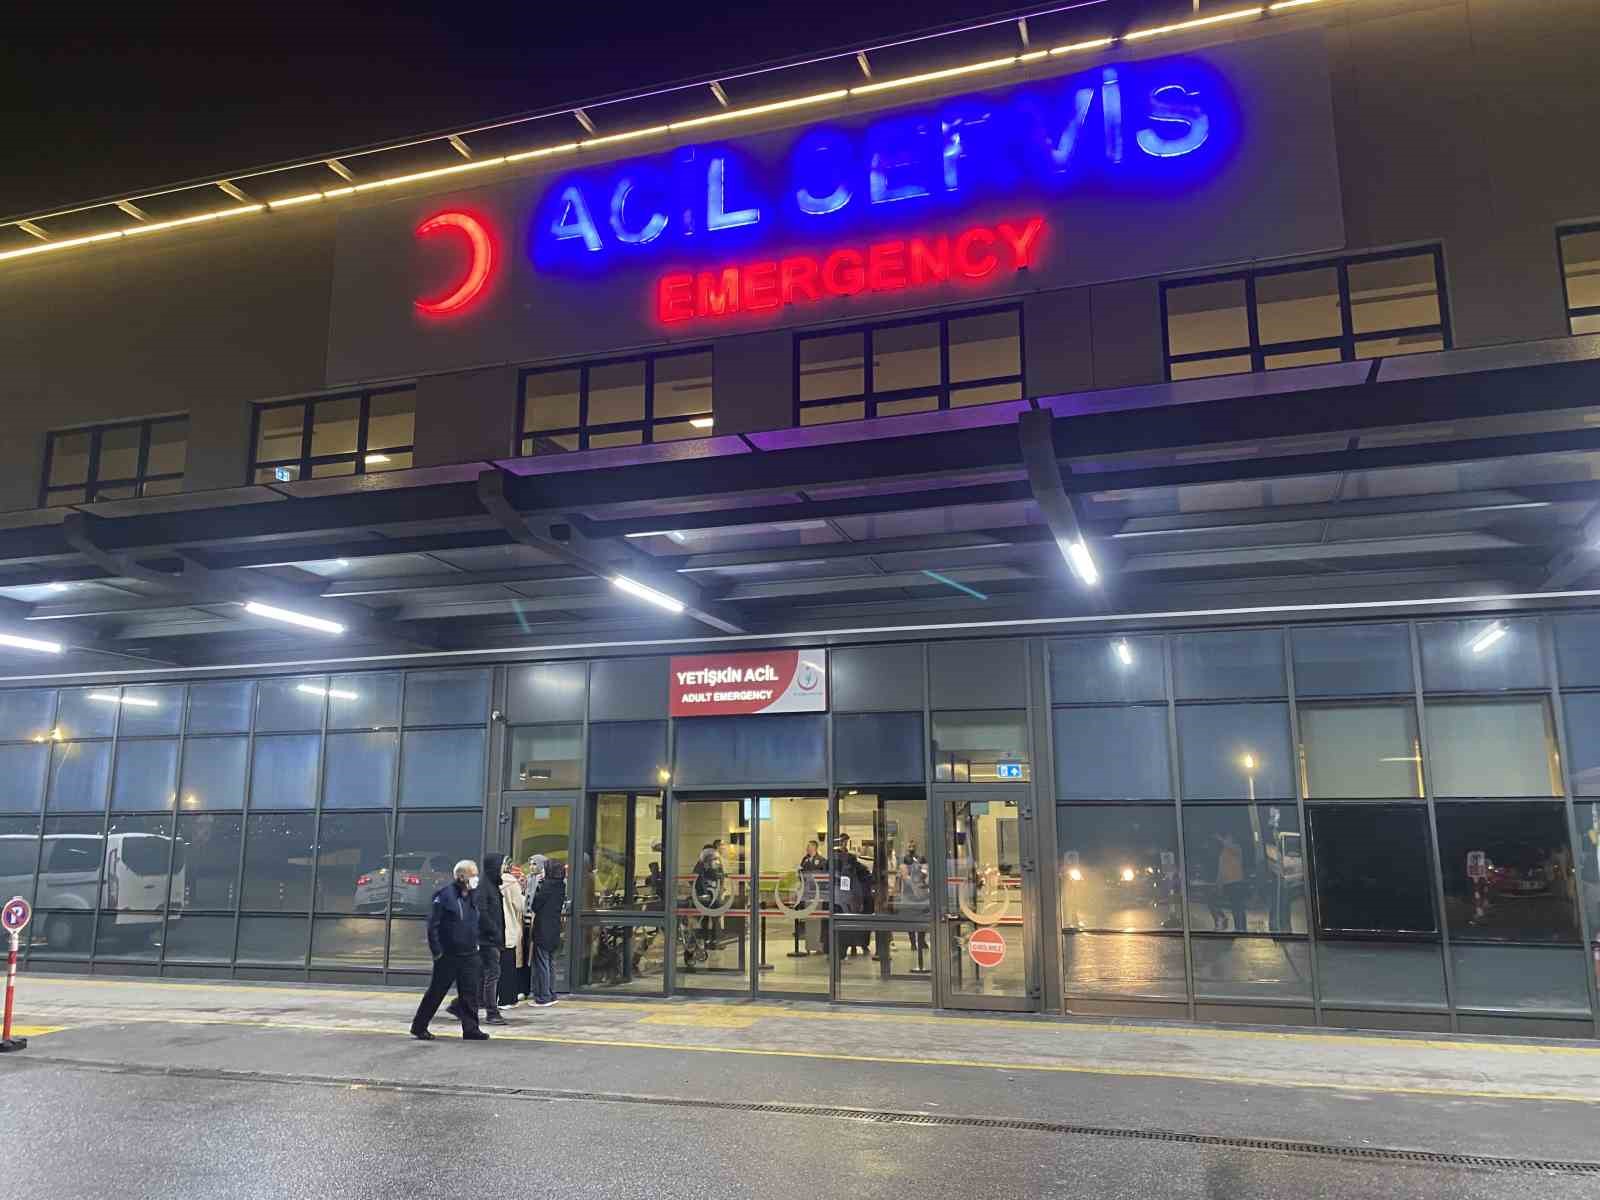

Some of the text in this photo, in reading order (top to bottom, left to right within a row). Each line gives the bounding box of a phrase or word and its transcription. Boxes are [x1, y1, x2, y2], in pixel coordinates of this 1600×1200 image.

[658, 216, 1044, 323] EMERGENCY
[676, 664, 779, 686] YETİŞKİN ACİL
[681, 689, 773, 703] ADULT EMERGENCY
